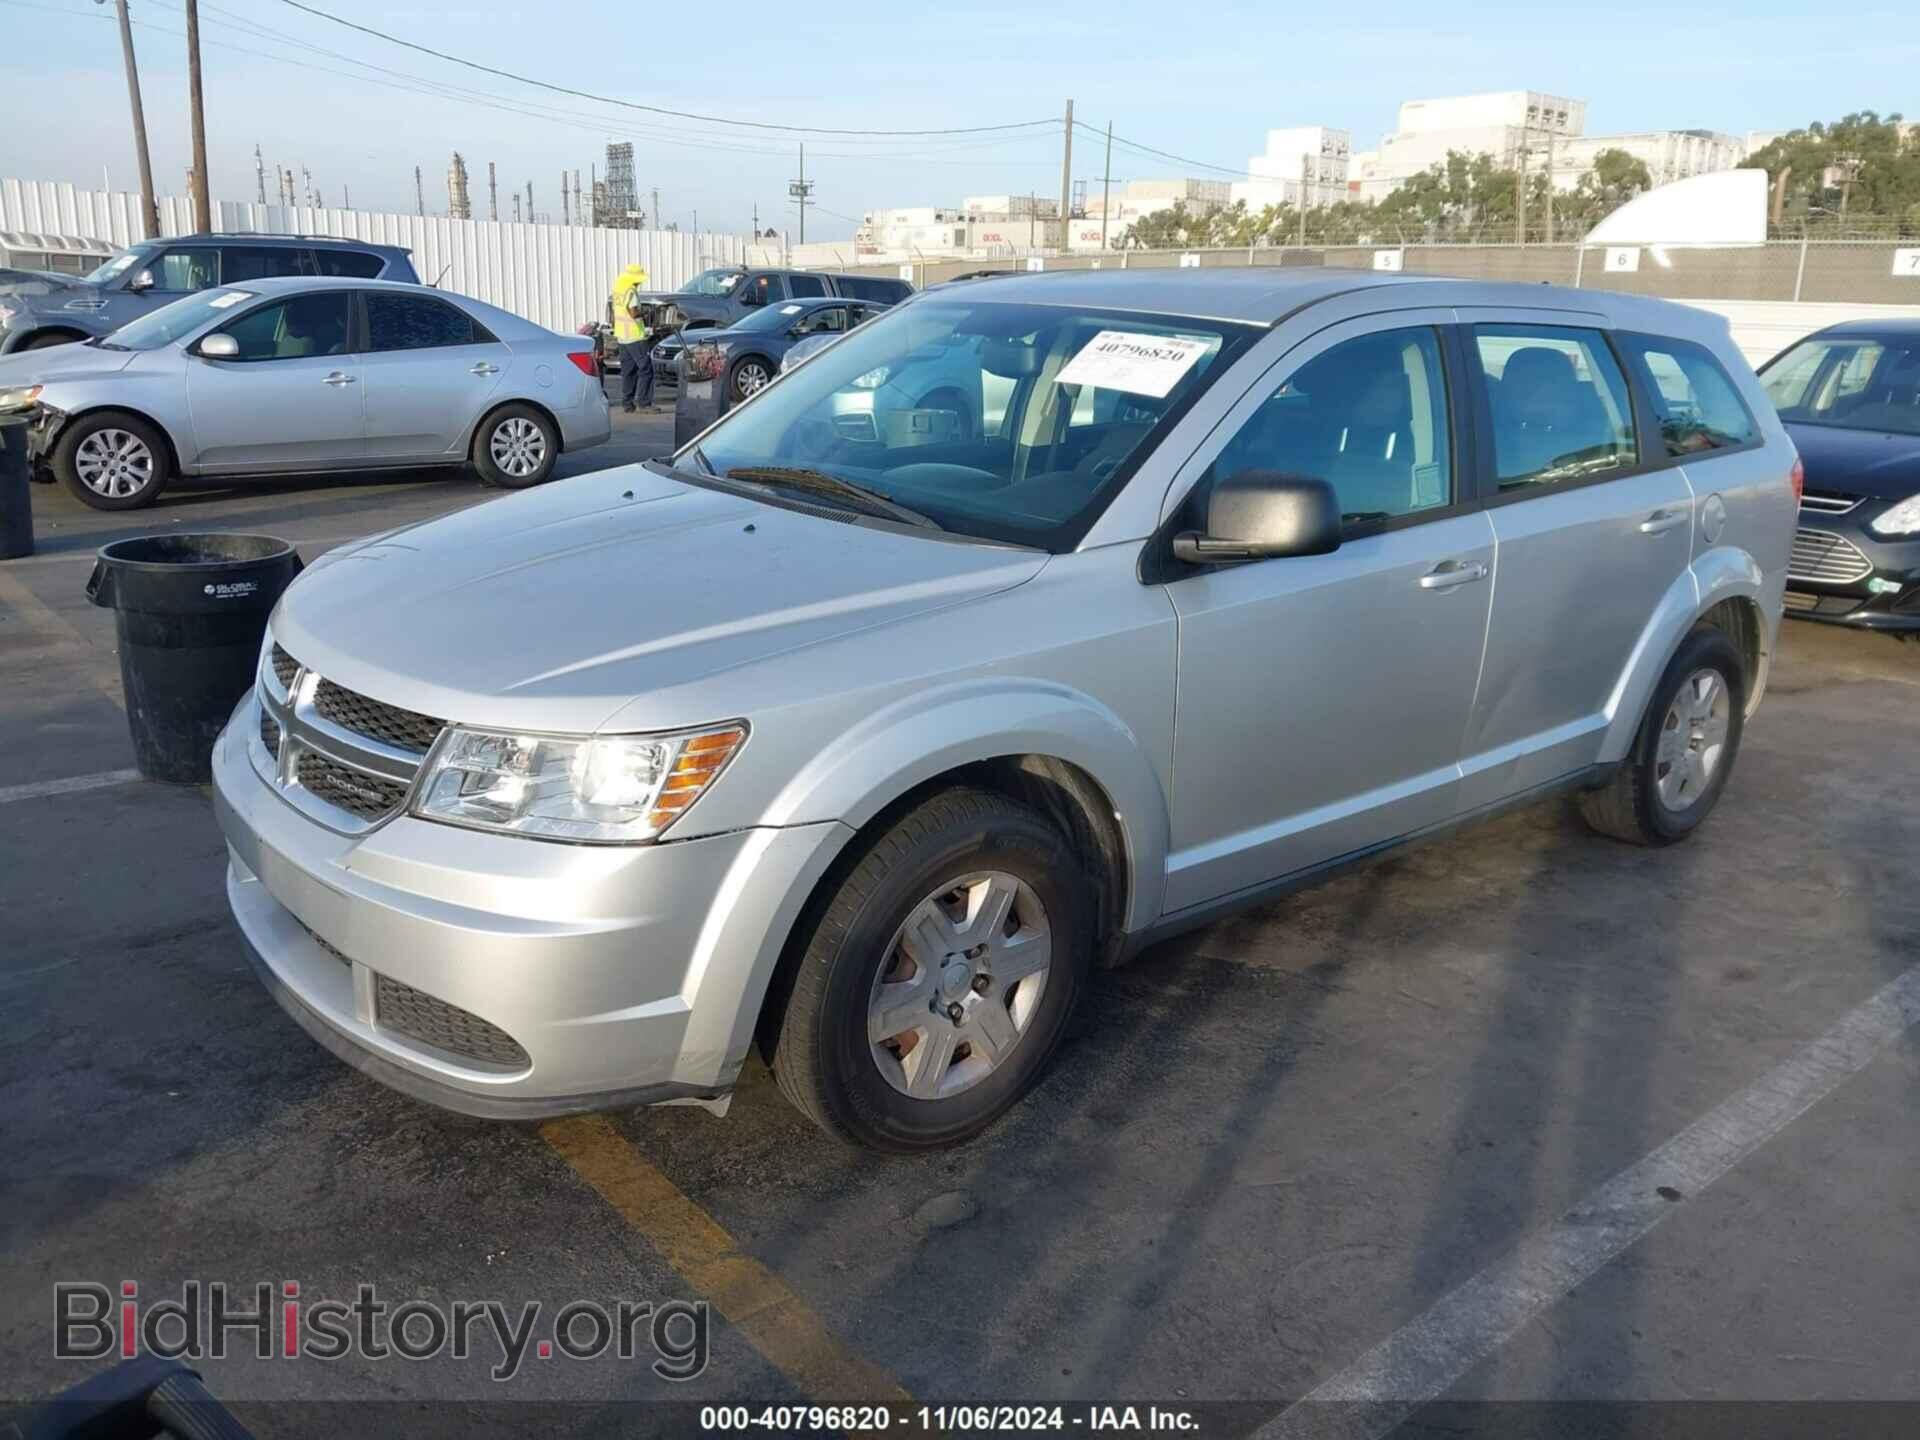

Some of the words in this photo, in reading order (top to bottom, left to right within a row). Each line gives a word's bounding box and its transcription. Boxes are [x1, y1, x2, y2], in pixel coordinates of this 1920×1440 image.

[1081, 232, 1102, 241] OOCL
[1383, 255, 1392, 267] 5
[1618, 254, 1628, 266] 6
[1911, 255, 1920, 269] 7
[1096, 342, 1185, 361] 40796820
[326, 774, 383, 801] DODGE
